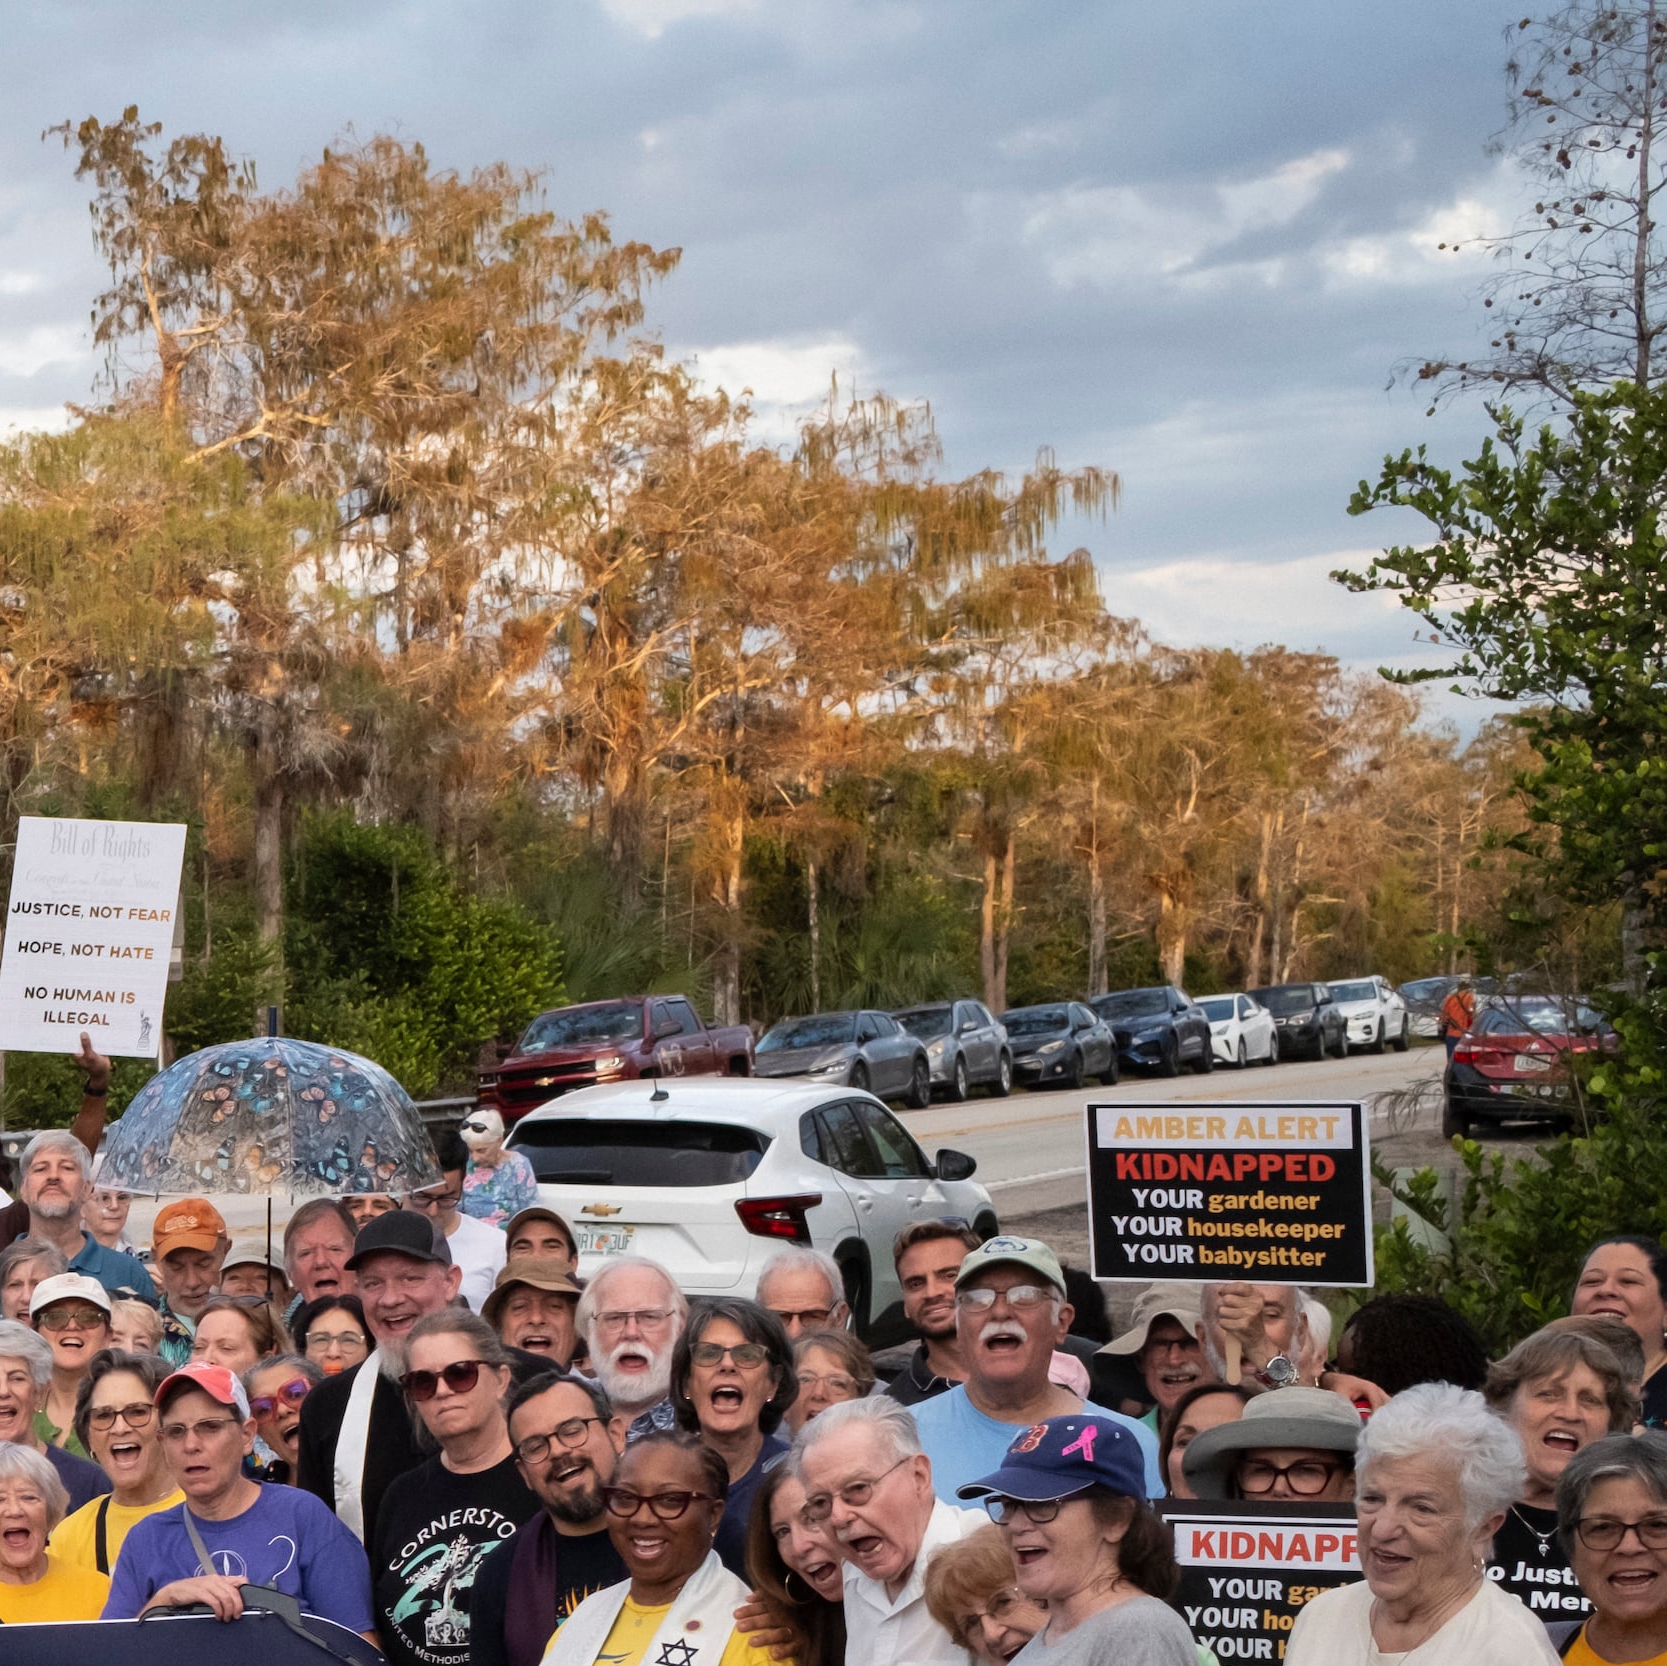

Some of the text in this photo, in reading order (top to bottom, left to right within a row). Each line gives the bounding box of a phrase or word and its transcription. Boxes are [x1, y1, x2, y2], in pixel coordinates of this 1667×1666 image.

[50, 822, 150, 863] Bill of Rights
[12, 902, 170, 922] JUSTICE, NOT FEAR
[18, 942, 154, 959] HOPE, NOT HATE
[25, 987, 135, 1004] NO HUMAN IS
[44, 1011, 109, 1025] ILLEGAL
[1114, 1115, 1341, 1140] AMBER ALERT
[1116, 1153, 1336, 1182] KIDNAPPED
[1132, 1188, 1320, 1213] YOUR gardener
[1112, 1216, 1345, 1241] YOUR housekeeper
[1122, 1242, 1326, 1267] YOUR babysitter
[1208, 1578, 1282, 1600] YOUR
[385, 1607, 414, 1649] UNITED
[1184, 1606, 1258, 1630] YOUR
[1198, 1636, 1272, 1659] YOUR
